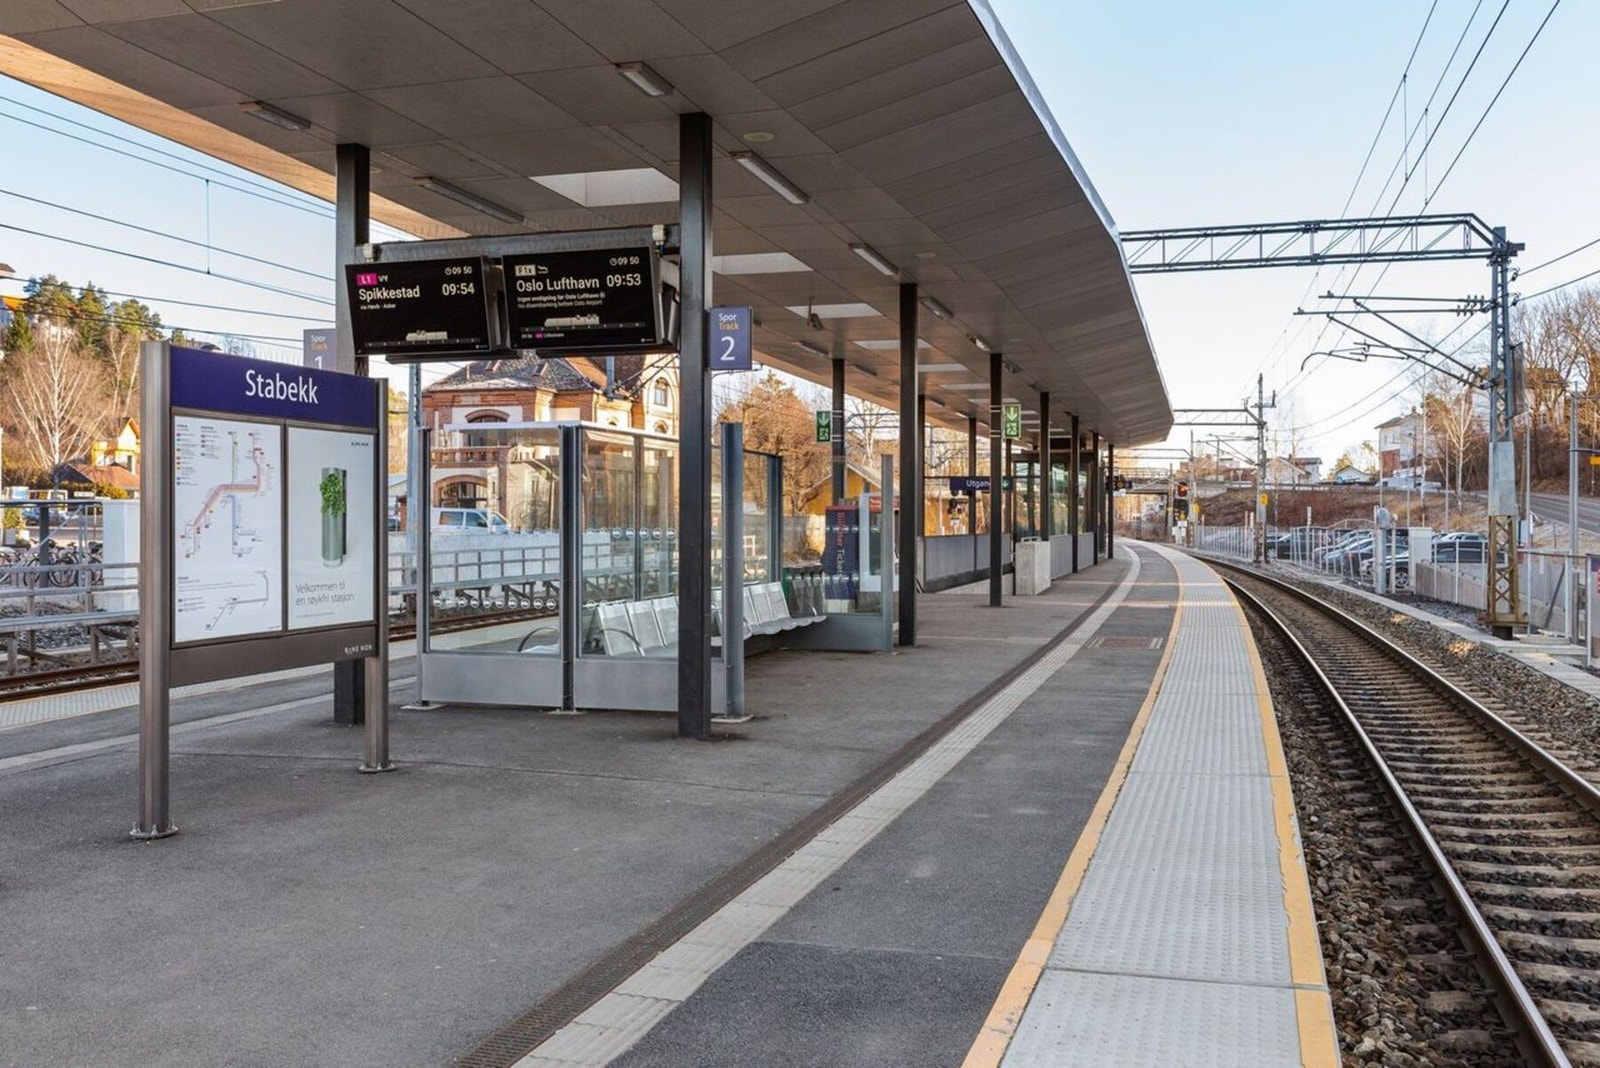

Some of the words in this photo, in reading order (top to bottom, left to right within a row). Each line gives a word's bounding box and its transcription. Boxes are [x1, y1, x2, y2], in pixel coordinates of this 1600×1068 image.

[361, 275, 372, 284] L1
[516, 278, 544, 292] Oslo
[546, 276, 600, 291] Lufthavn
[606, 273, 642, 287] 09:53
[358, 285, 420, 302] Spikkestad
[442, 282, 475, 296] 09:54
[718, 313, 737, 322] Spor
[719, 321, 740, 331] Track
[310, 334, 326, 343] Spor
[720, 336, 735, 361] 2
[314, 355, 322, 370] 1
[245, 369, 319, 405] Stabekk
[965, 479, 991, 489] Utgan
[295, 582, 338, 594] Velkommen
[295, 597, 306, 607] en
